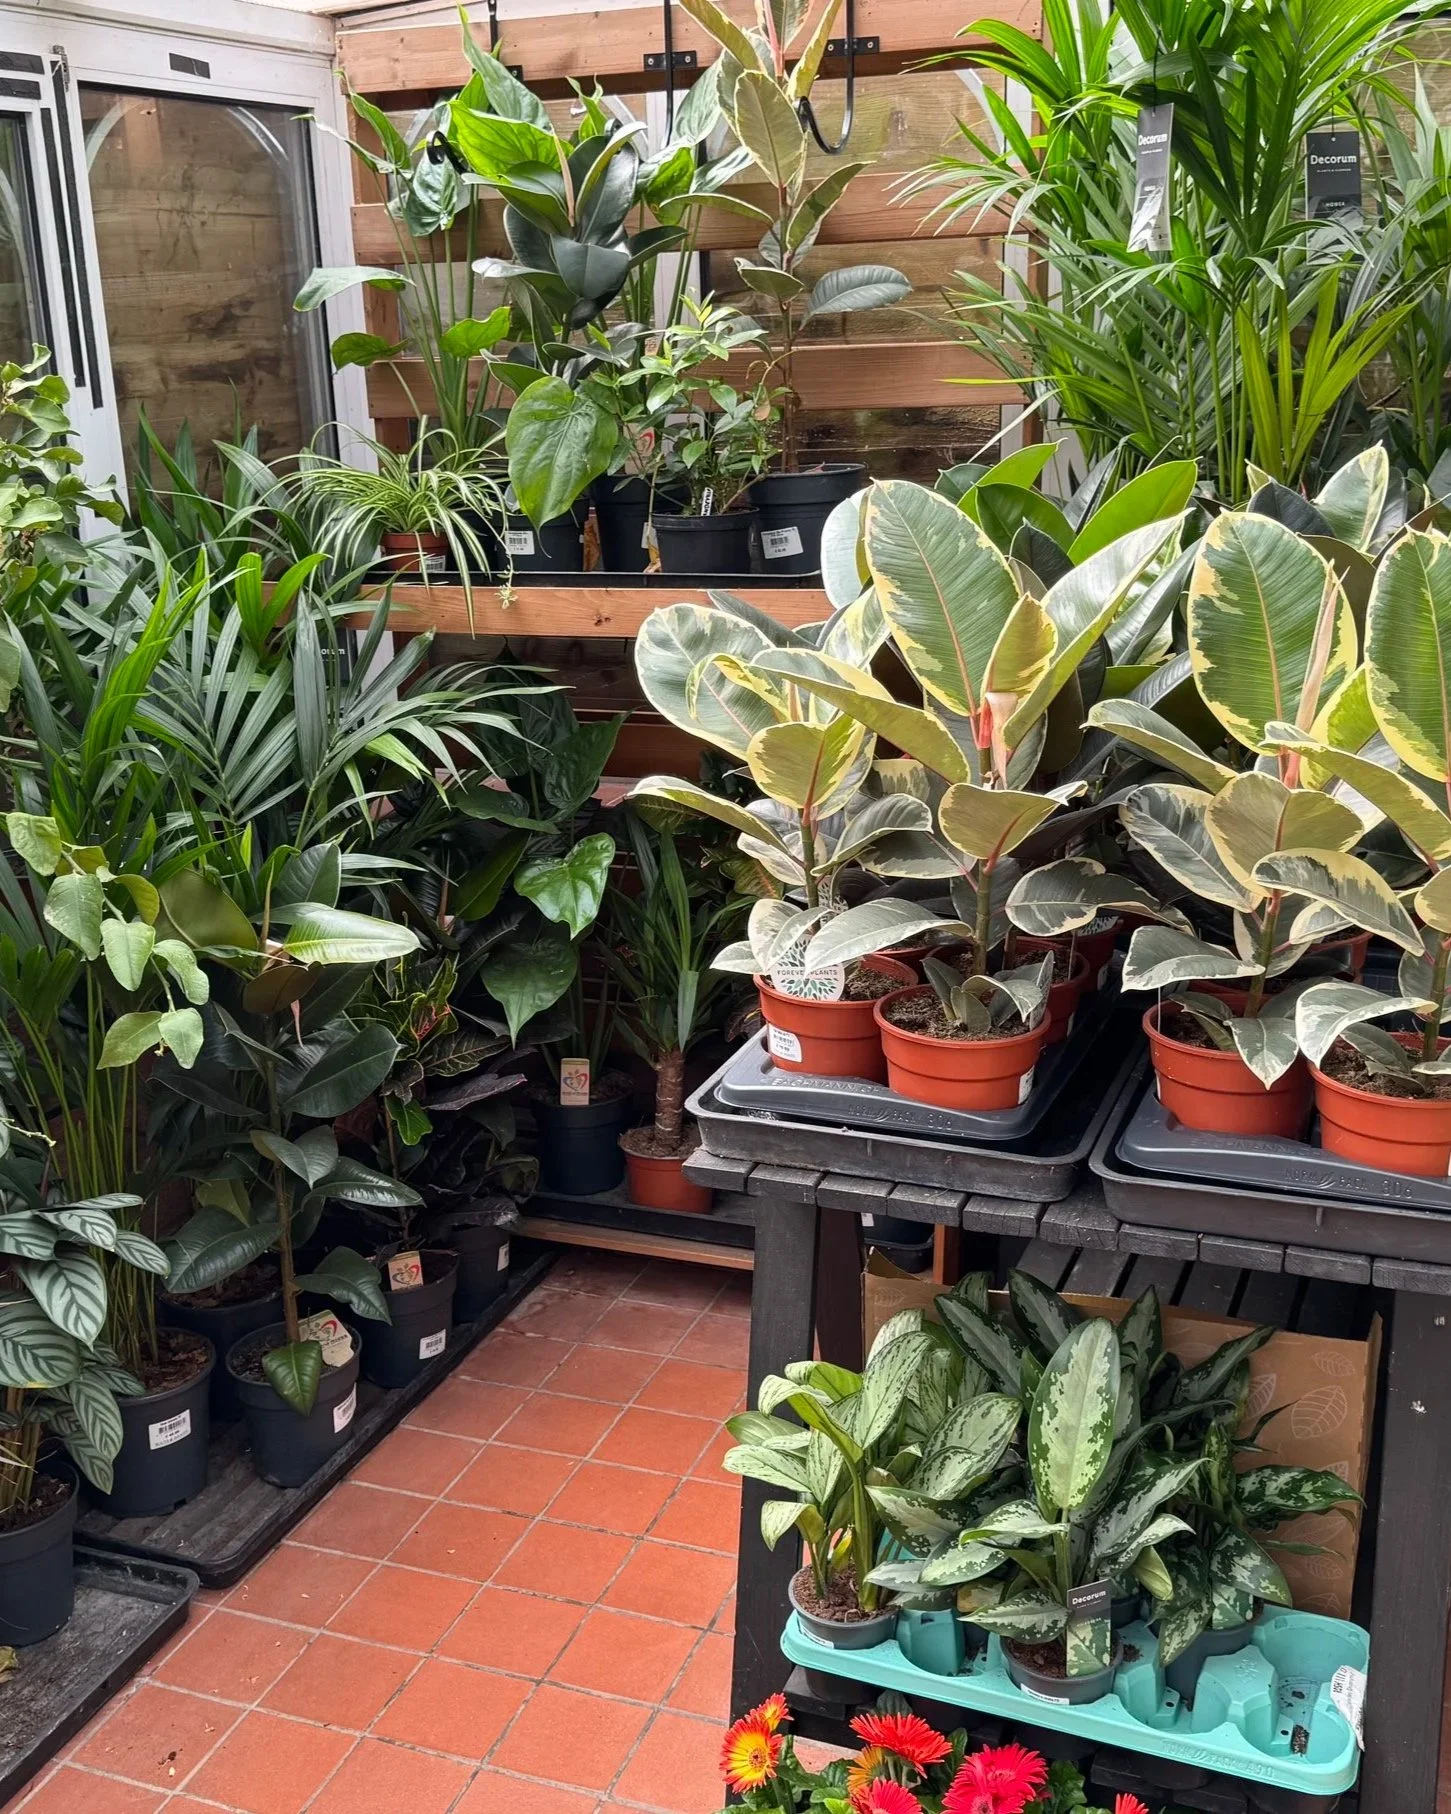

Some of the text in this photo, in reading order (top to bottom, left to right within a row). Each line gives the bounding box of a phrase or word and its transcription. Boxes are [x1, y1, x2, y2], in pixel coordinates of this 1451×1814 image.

[1310, 154, 1357, 165] Decorum
[1381, 1178, 1414, 1199] 306
[1072, 1590, 1106, 1605] Decorum
